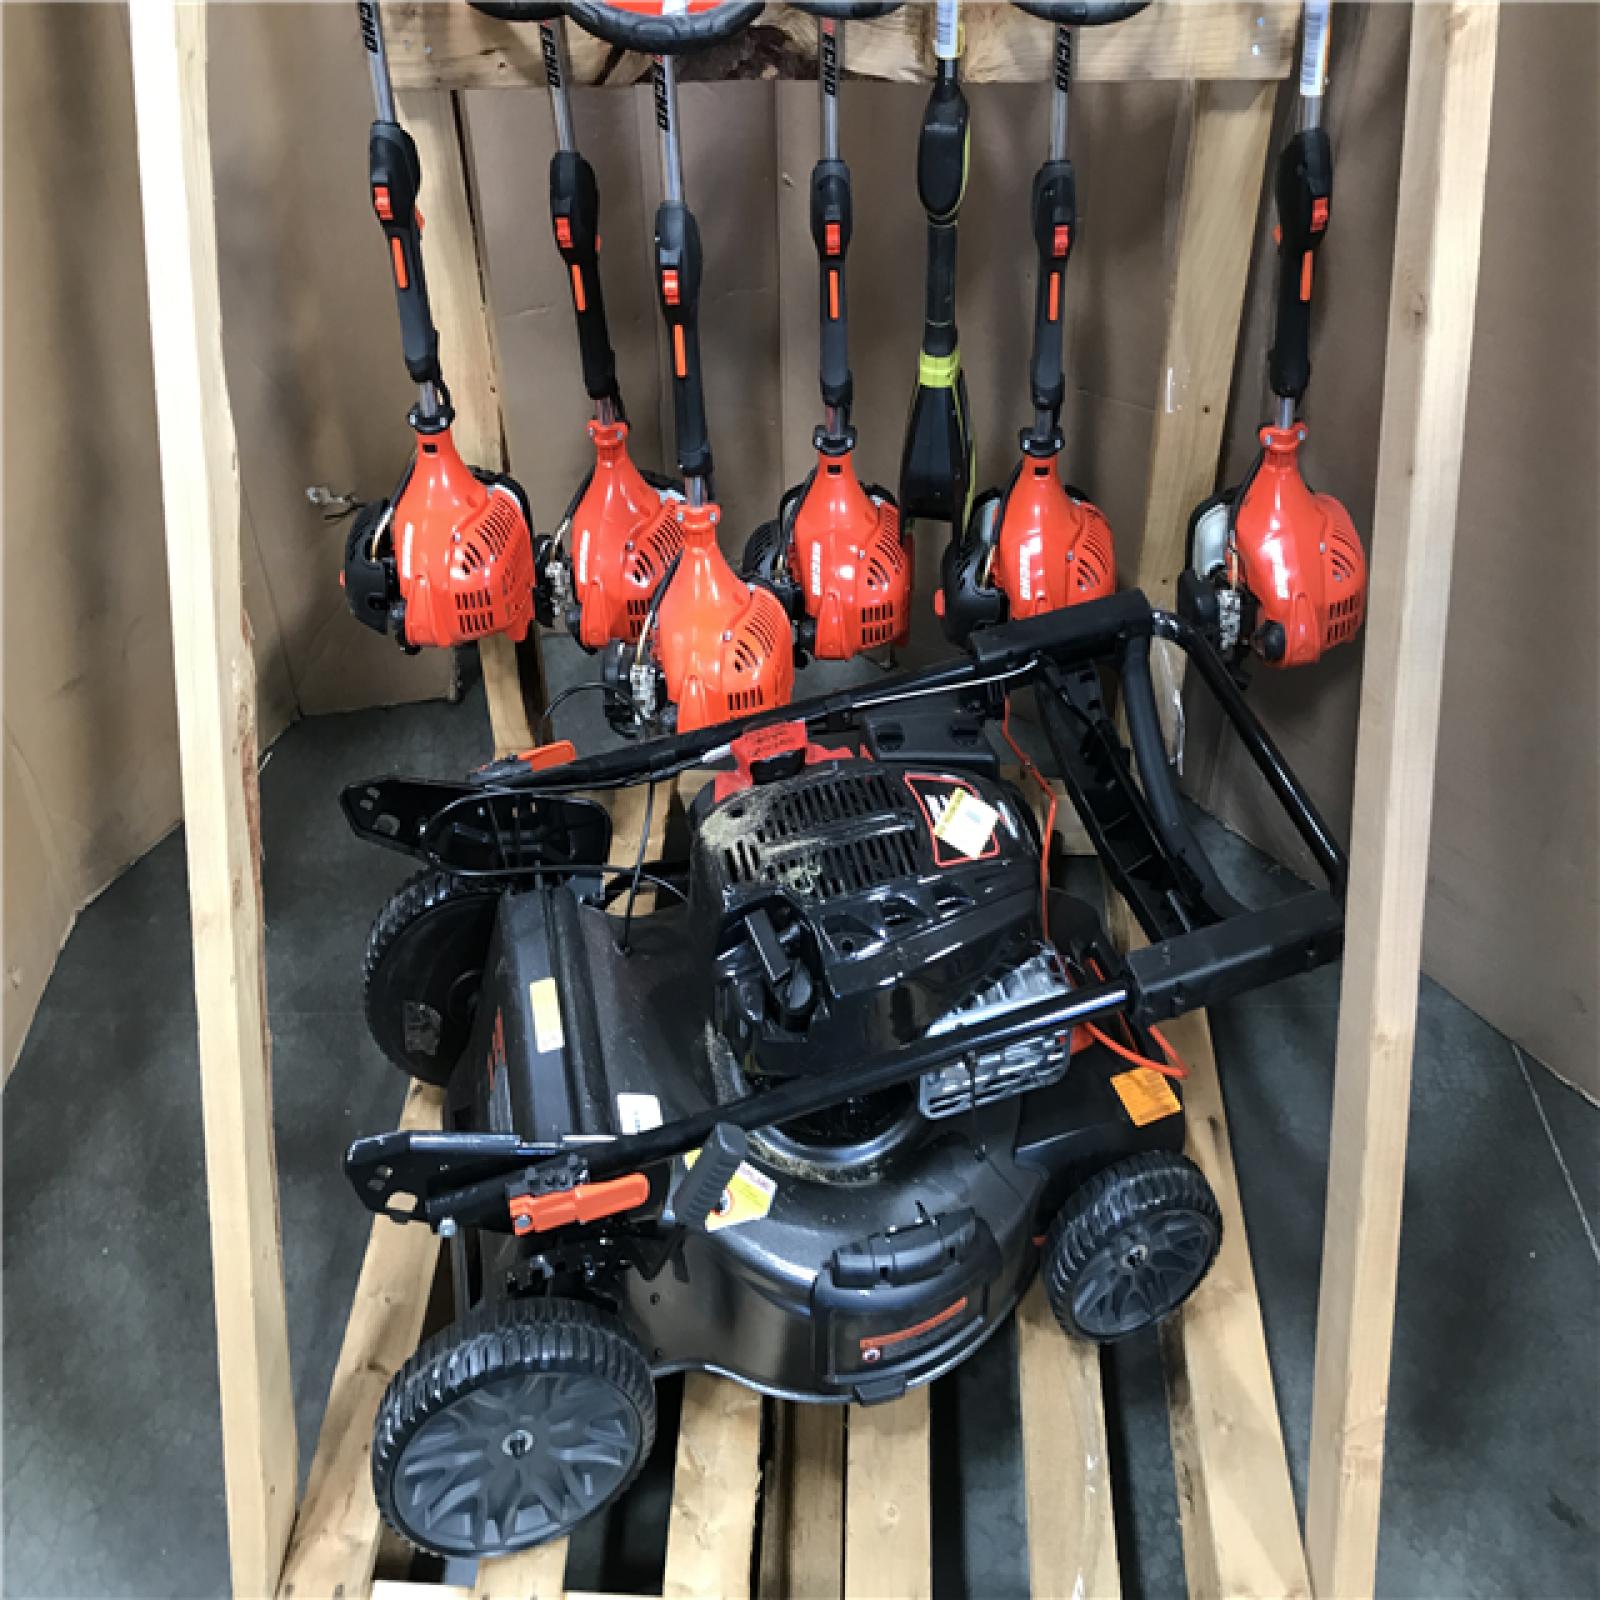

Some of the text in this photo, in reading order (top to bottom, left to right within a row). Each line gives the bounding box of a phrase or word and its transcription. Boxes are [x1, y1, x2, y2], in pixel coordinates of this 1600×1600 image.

[539, 24, 561, 88] ECHO
[822, 33, 836, 95] ECHO
[1055, 27, 1071, 92] ECHO
[653, 63, 670, 131] ECHO
